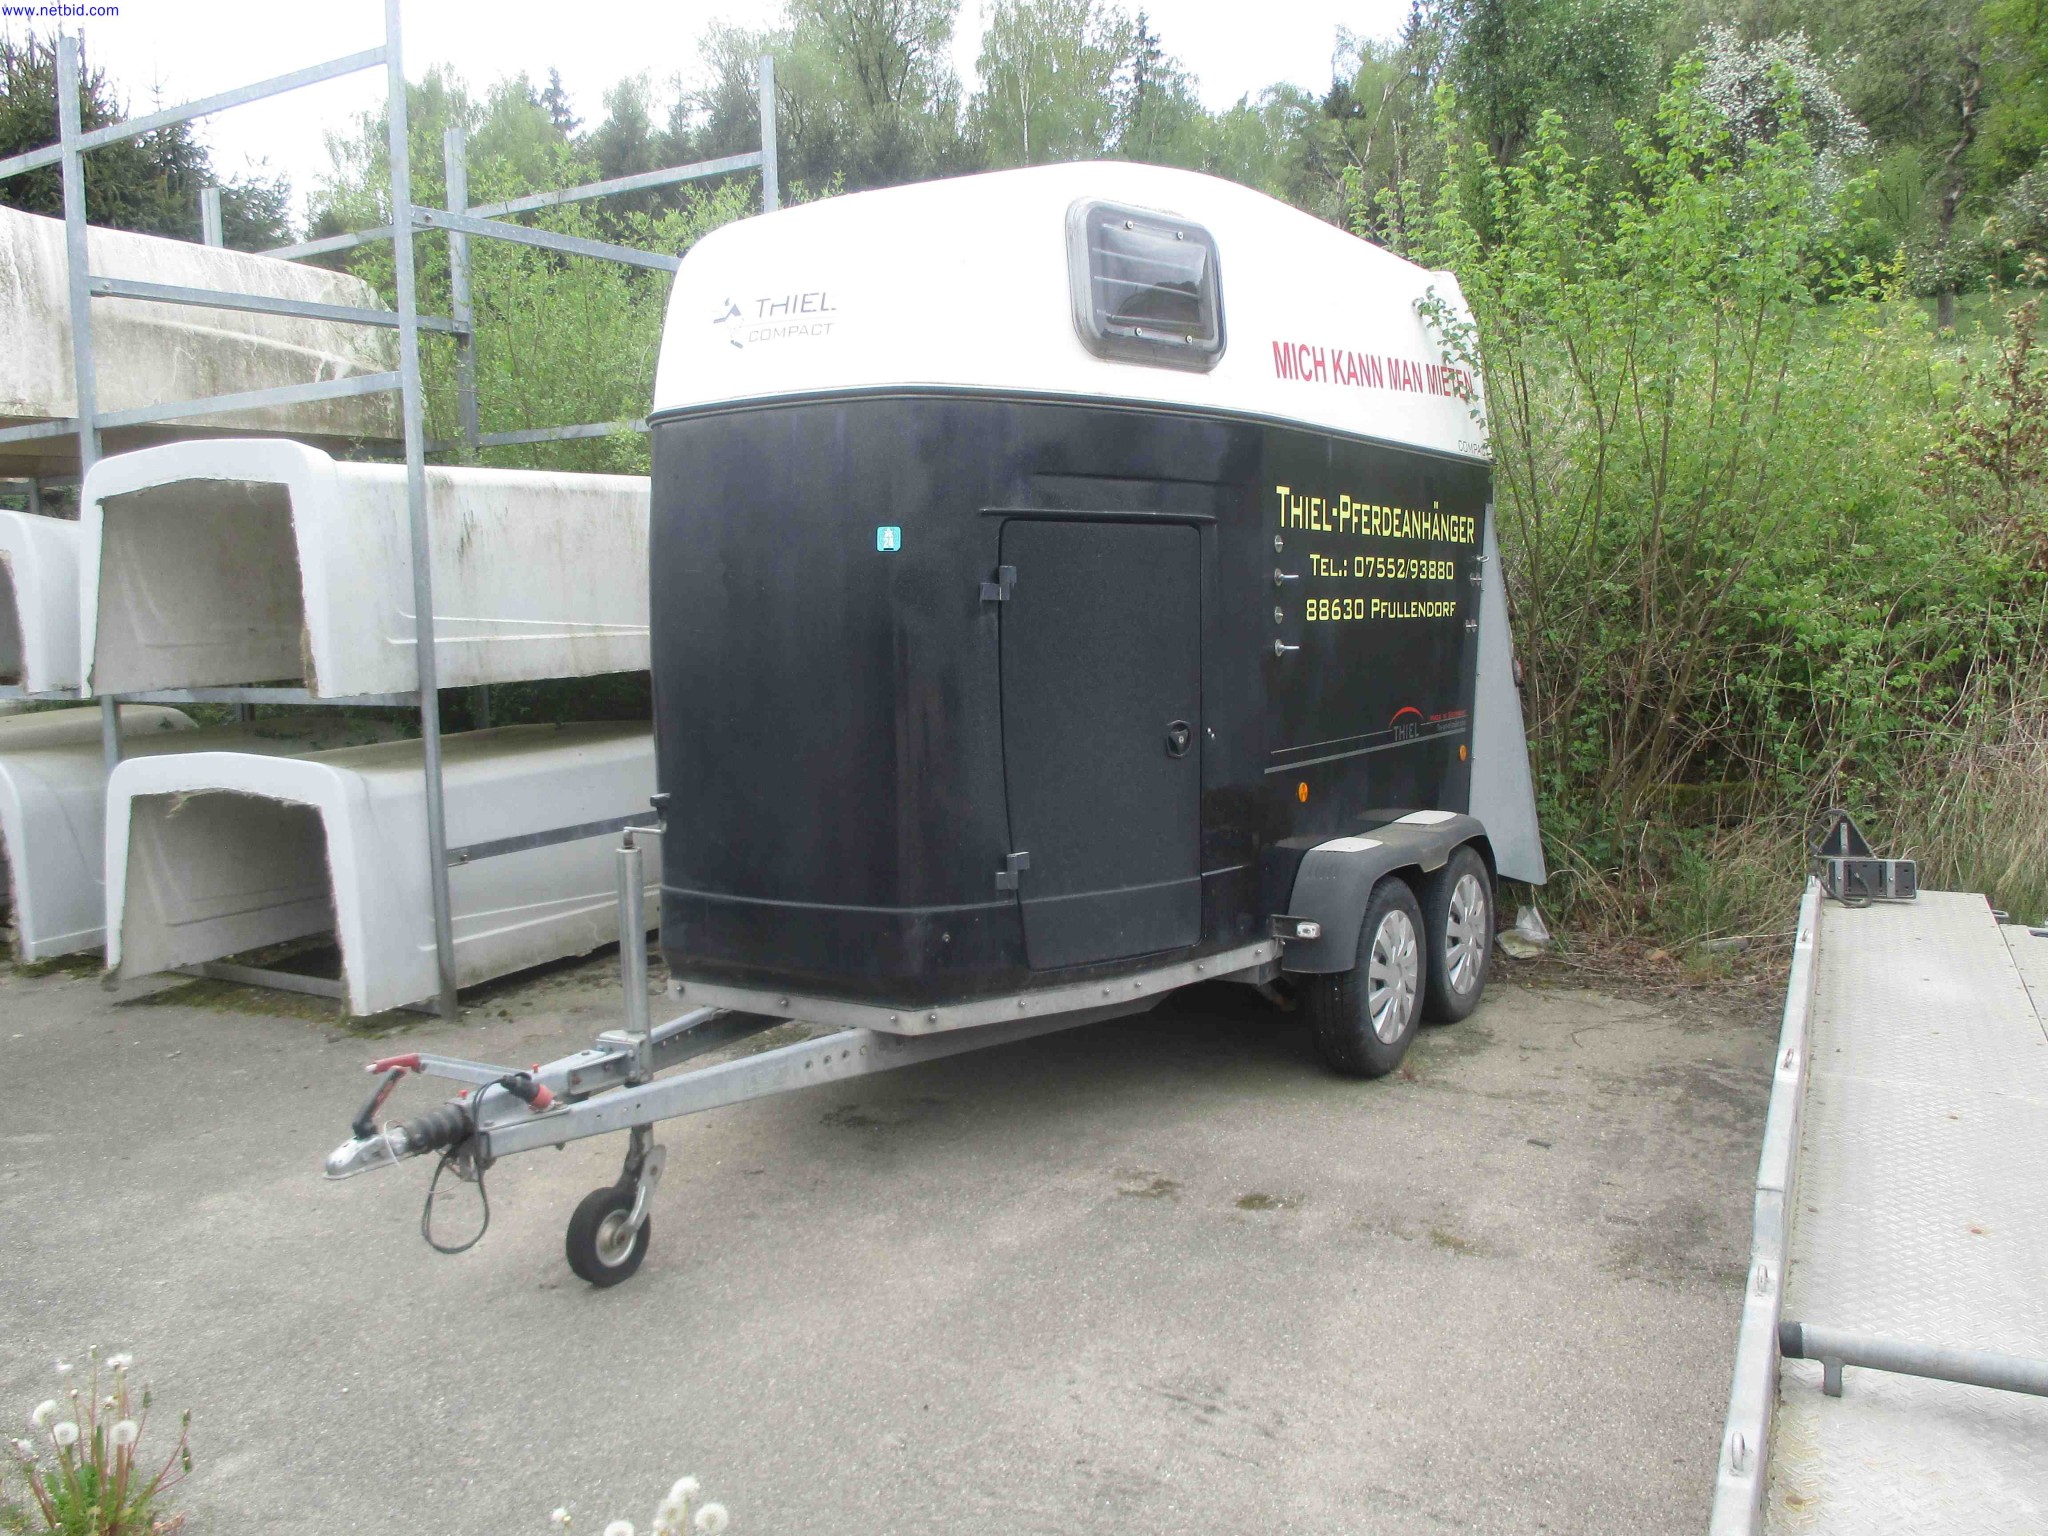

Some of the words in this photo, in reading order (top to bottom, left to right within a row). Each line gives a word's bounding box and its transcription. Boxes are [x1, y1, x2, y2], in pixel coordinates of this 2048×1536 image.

[756, 292, 837, 318] THIEL
[748, 322, 835, 343] COMPACT
[1272, 340, 1328, 384] MICH
[1331, 348, 1384, 389] KANN
[1387, 357, 1423, 394] MAN
[1309, 553, 1348, 577] TEL.:
[1354, 556, 1454, 580] 07552/93880
[1306, 598, 1364, 621] 88630
[1371, 598, 1457, 619] PFULLENDORF
[1393, 721, 1420, 741] THIEL
